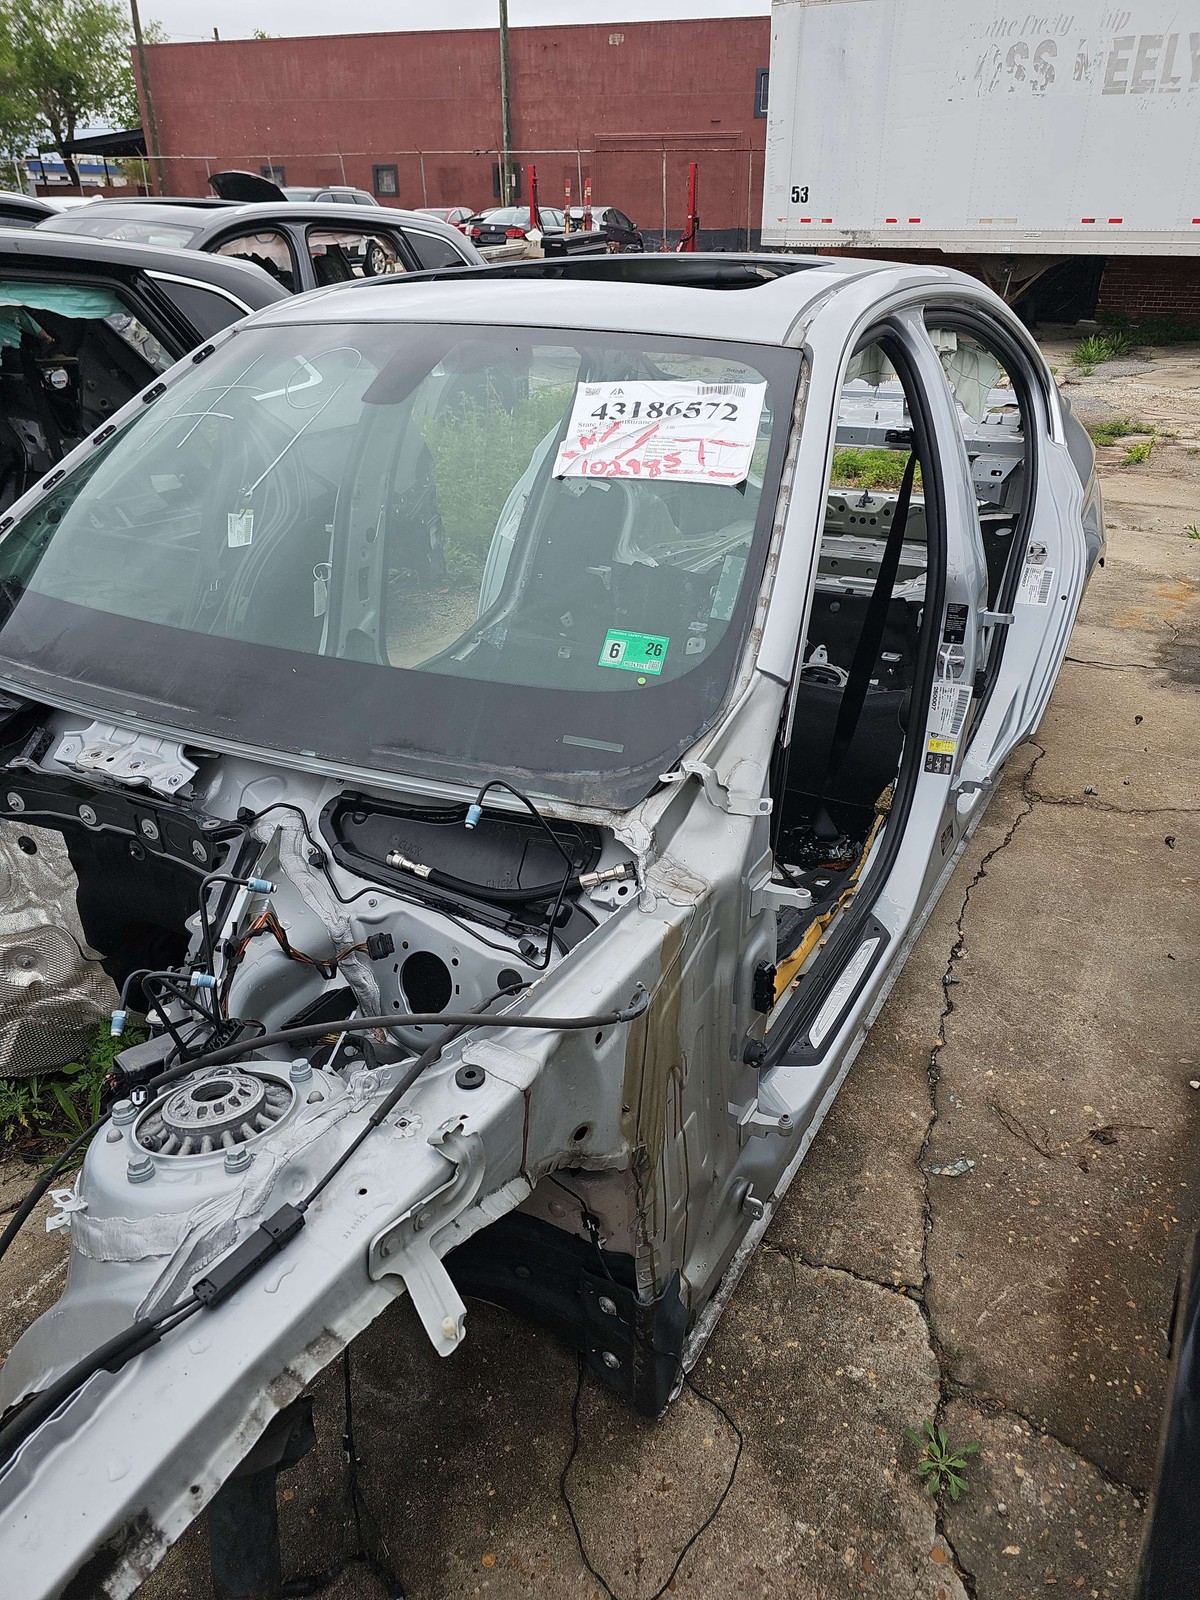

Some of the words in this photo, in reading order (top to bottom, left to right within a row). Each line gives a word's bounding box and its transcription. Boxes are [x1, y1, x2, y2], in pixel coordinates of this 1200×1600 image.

[791, 185, 809, 204] 53
[590, 401, 739, 422] 43186572
[609, 642, 621, 659] 6
[645, 642, 663, 657] 26
[398, 840, 423, 857] CLICK
[486, 878, 514, 889] CLICK
